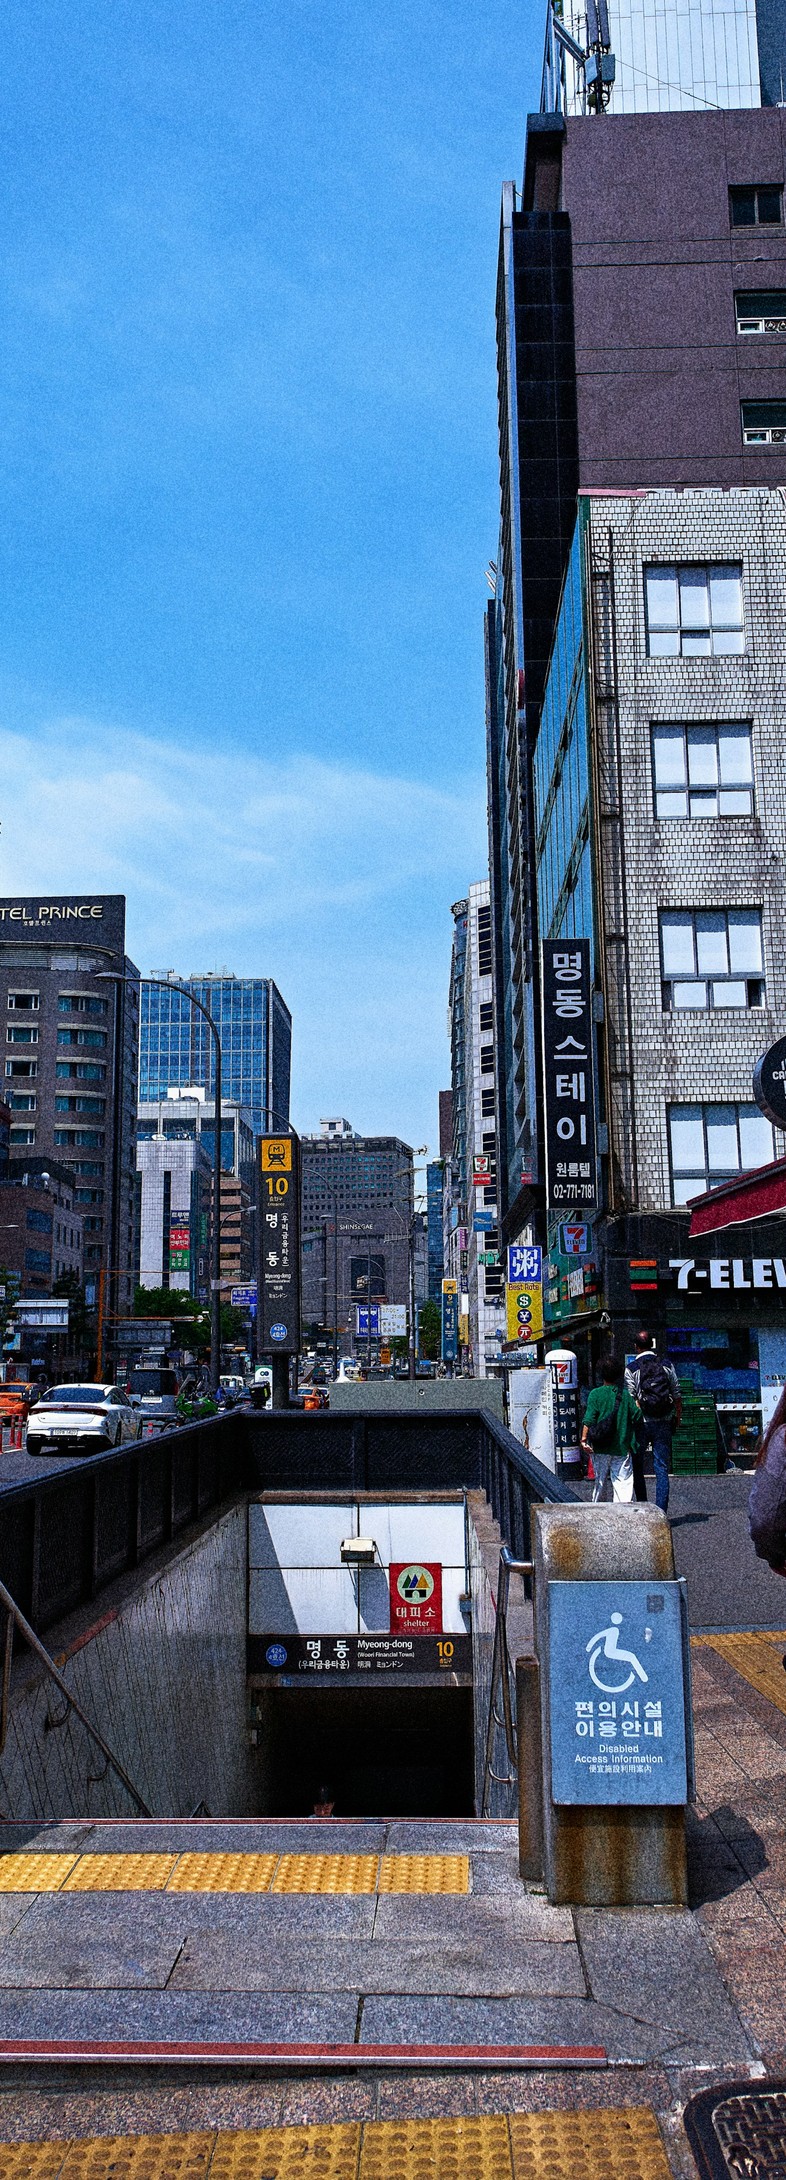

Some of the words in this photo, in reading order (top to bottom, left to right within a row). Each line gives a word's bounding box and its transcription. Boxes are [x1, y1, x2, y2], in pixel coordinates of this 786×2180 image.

[38, 905, 103, 919] PRINCE
[556, 1162, 590, 1178] 원룸텔
[265, 1177, 289, 1195] 10
[554, 1184, 595, 1200] 02-771-7181
[567, 1227, 584, 1253] 7
[512, 1248, 539, 1277] 粥
[508, 1283, 523, 1291] Best
[524, 1283, 539, 1291] Rate
[403, 1619, 430, 1627] shelter
[357, 1640, 413, 1650] Myeong-dong
[436, 1641, 454, 1657] 10
[298, 1660, 350, 1670] (우리금융타운)
[575, 1701, 662, 1718] 편의시설
[575, 1720, 663, 1738] 이용안내
[599, 1744, 639, 1753] Disabled
[574, 1754, 608, 1763] Access
[611, 1754, 663, 1763] Information
